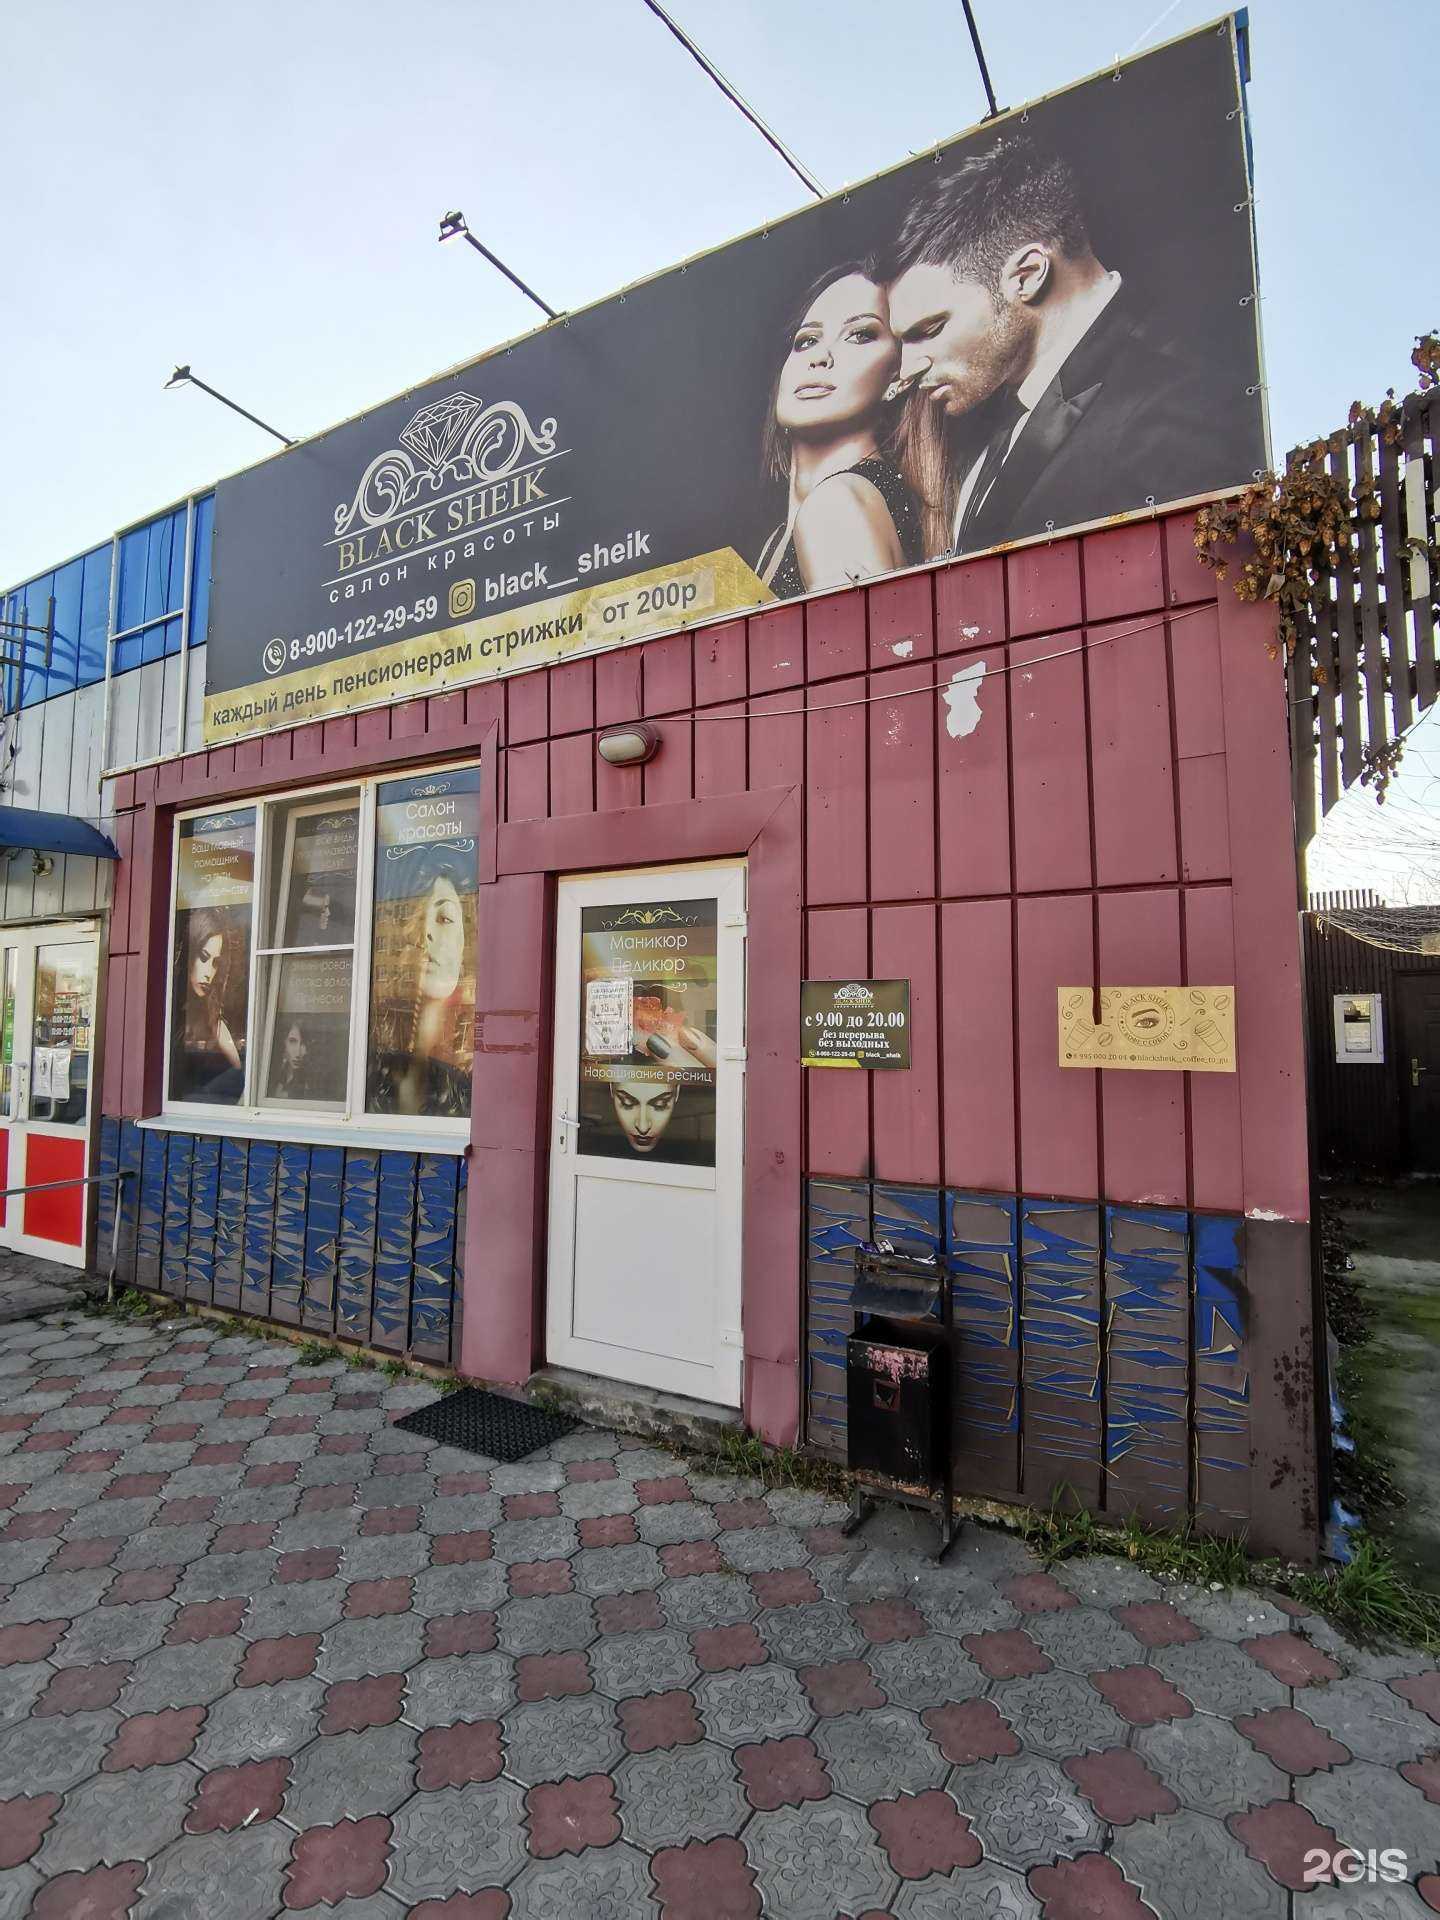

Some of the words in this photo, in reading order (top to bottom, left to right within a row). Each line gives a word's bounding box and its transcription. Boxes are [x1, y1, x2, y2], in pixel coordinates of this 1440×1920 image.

[337, 511, 436, 573] BLACK
[447, 468, 548, 533] SHEIK
[329, 564, 409, 604] салон
[427, 512, 562, 571] красоты
[289, 595, 439, 662] 8-900-122-29-59
[212, 690, 279, 727] каждый
[283, 681, 328, 710] день
[332, 643, 473, 696] пенсионерам
[480, 612, 584, 658] стрижки
[602, 601, 630, 624] от
[636, 581, 698, 617] 200р
[406, 800, 455, 819] Салон
[398, 820, 462, 841] красоты
[610, 933, 688, 951] Маникюр
[612, 957, 686, 974] Педикюр
[805, 1016, 812, 1027] с
[815, 1012, 843, 1027] 9.00
[846, 1016, 863, 1029] до
[867, 1012, 905, 1027] 20.00
[818, 1038, 834, 1047] без
[836, 1040, 890, 1049] выходных
[823, 1030, 837, 1039] без
[839, 1031, 885, 1041] перерыва
[584, 1065, 664, 1081] Наращивание
[667, 1069, 712, 1084] ресниц
